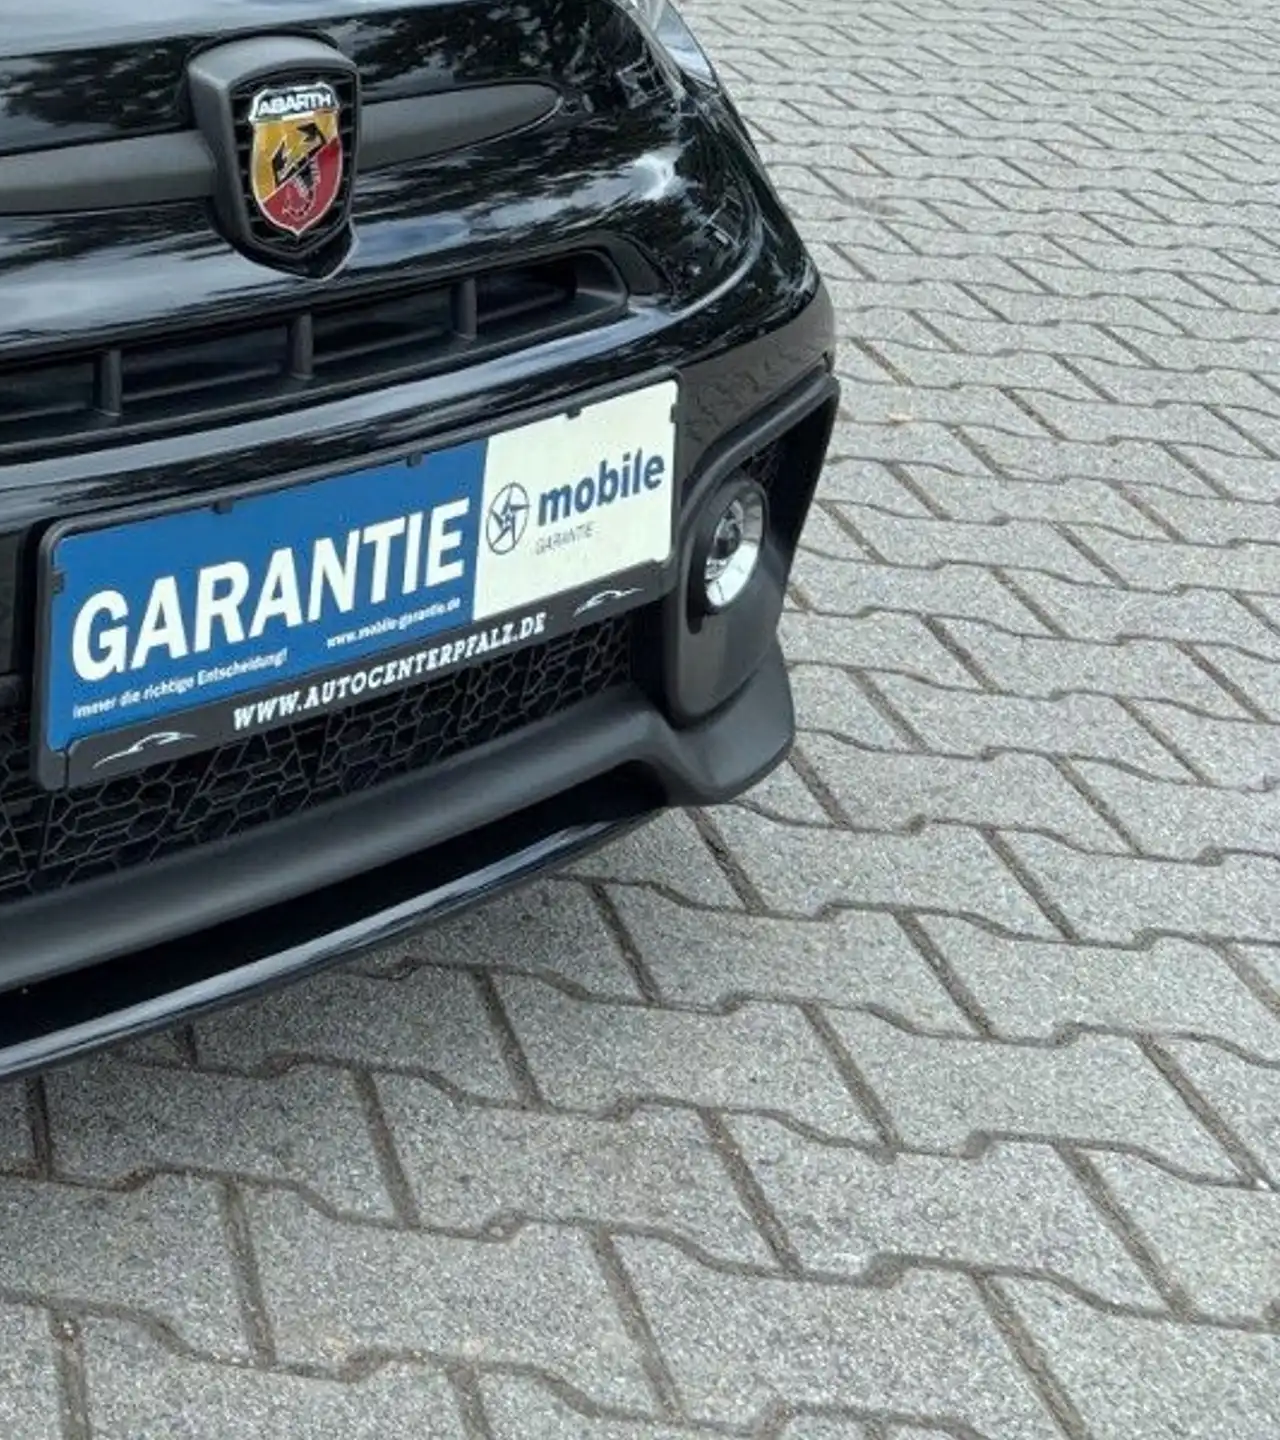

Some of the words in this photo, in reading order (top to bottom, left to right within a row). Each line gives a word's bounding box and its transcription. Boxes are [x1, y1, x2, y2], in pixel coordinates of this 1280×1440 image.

[258, 92, 332, 114] ABARTH
[538, 446, 665, 527] mobile
[70, 496, 470, 683] GARANTIE
[233, 611, 548, 731] WWW.AUTOCENTERPFALZ.DE
